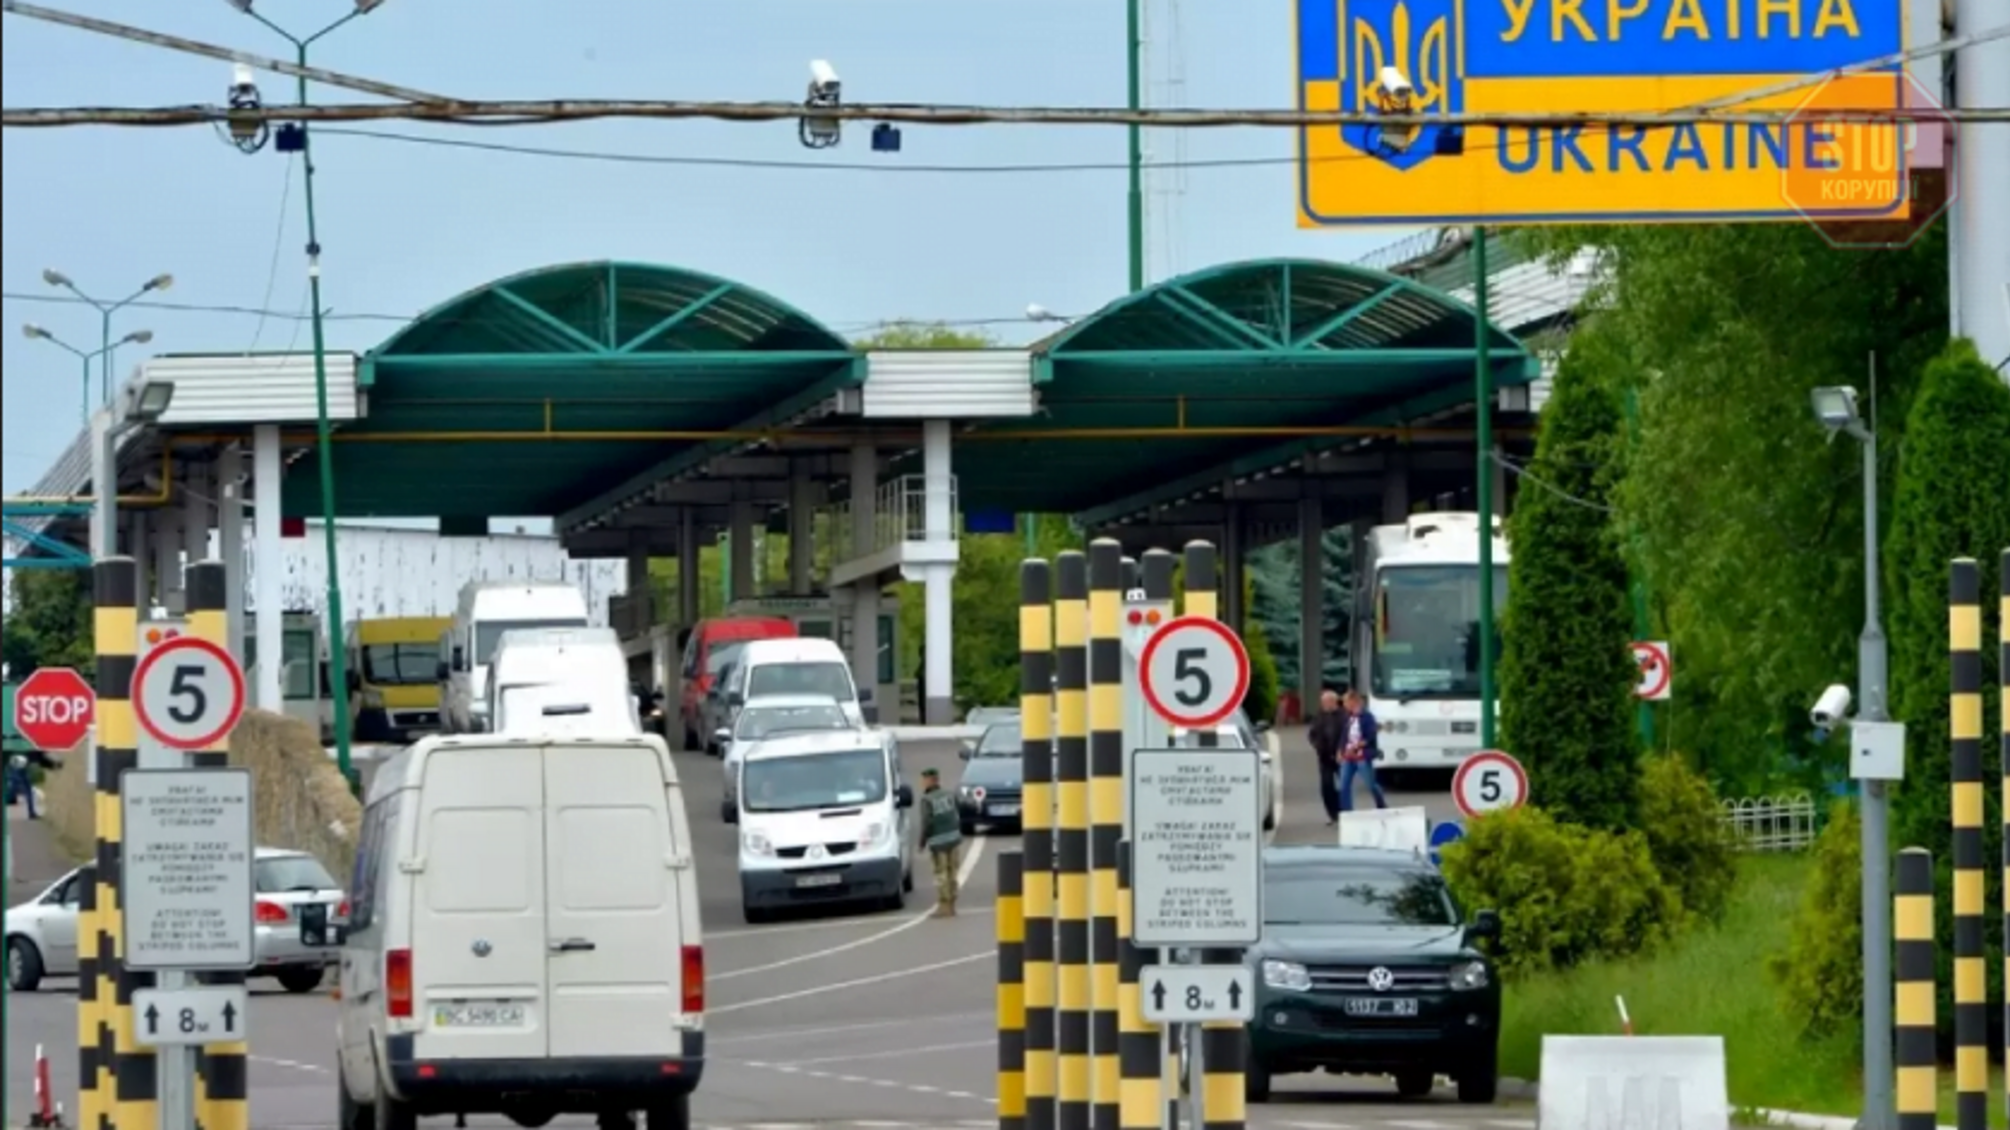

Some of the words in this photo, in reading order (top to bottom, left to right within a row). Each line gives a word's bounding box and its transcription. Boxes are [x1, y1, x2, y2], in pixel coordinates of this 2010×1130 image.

[1499, 0, 1861, 41] УКРАЇНА
[1496, 117, 1840, 173] UKRAINE
[167, 665, 207, 724] 5
[1174, 647, 1212, 707] 5
[22, 696, 89, 724] STOP
[1480, 770, 1502, 802] 5
